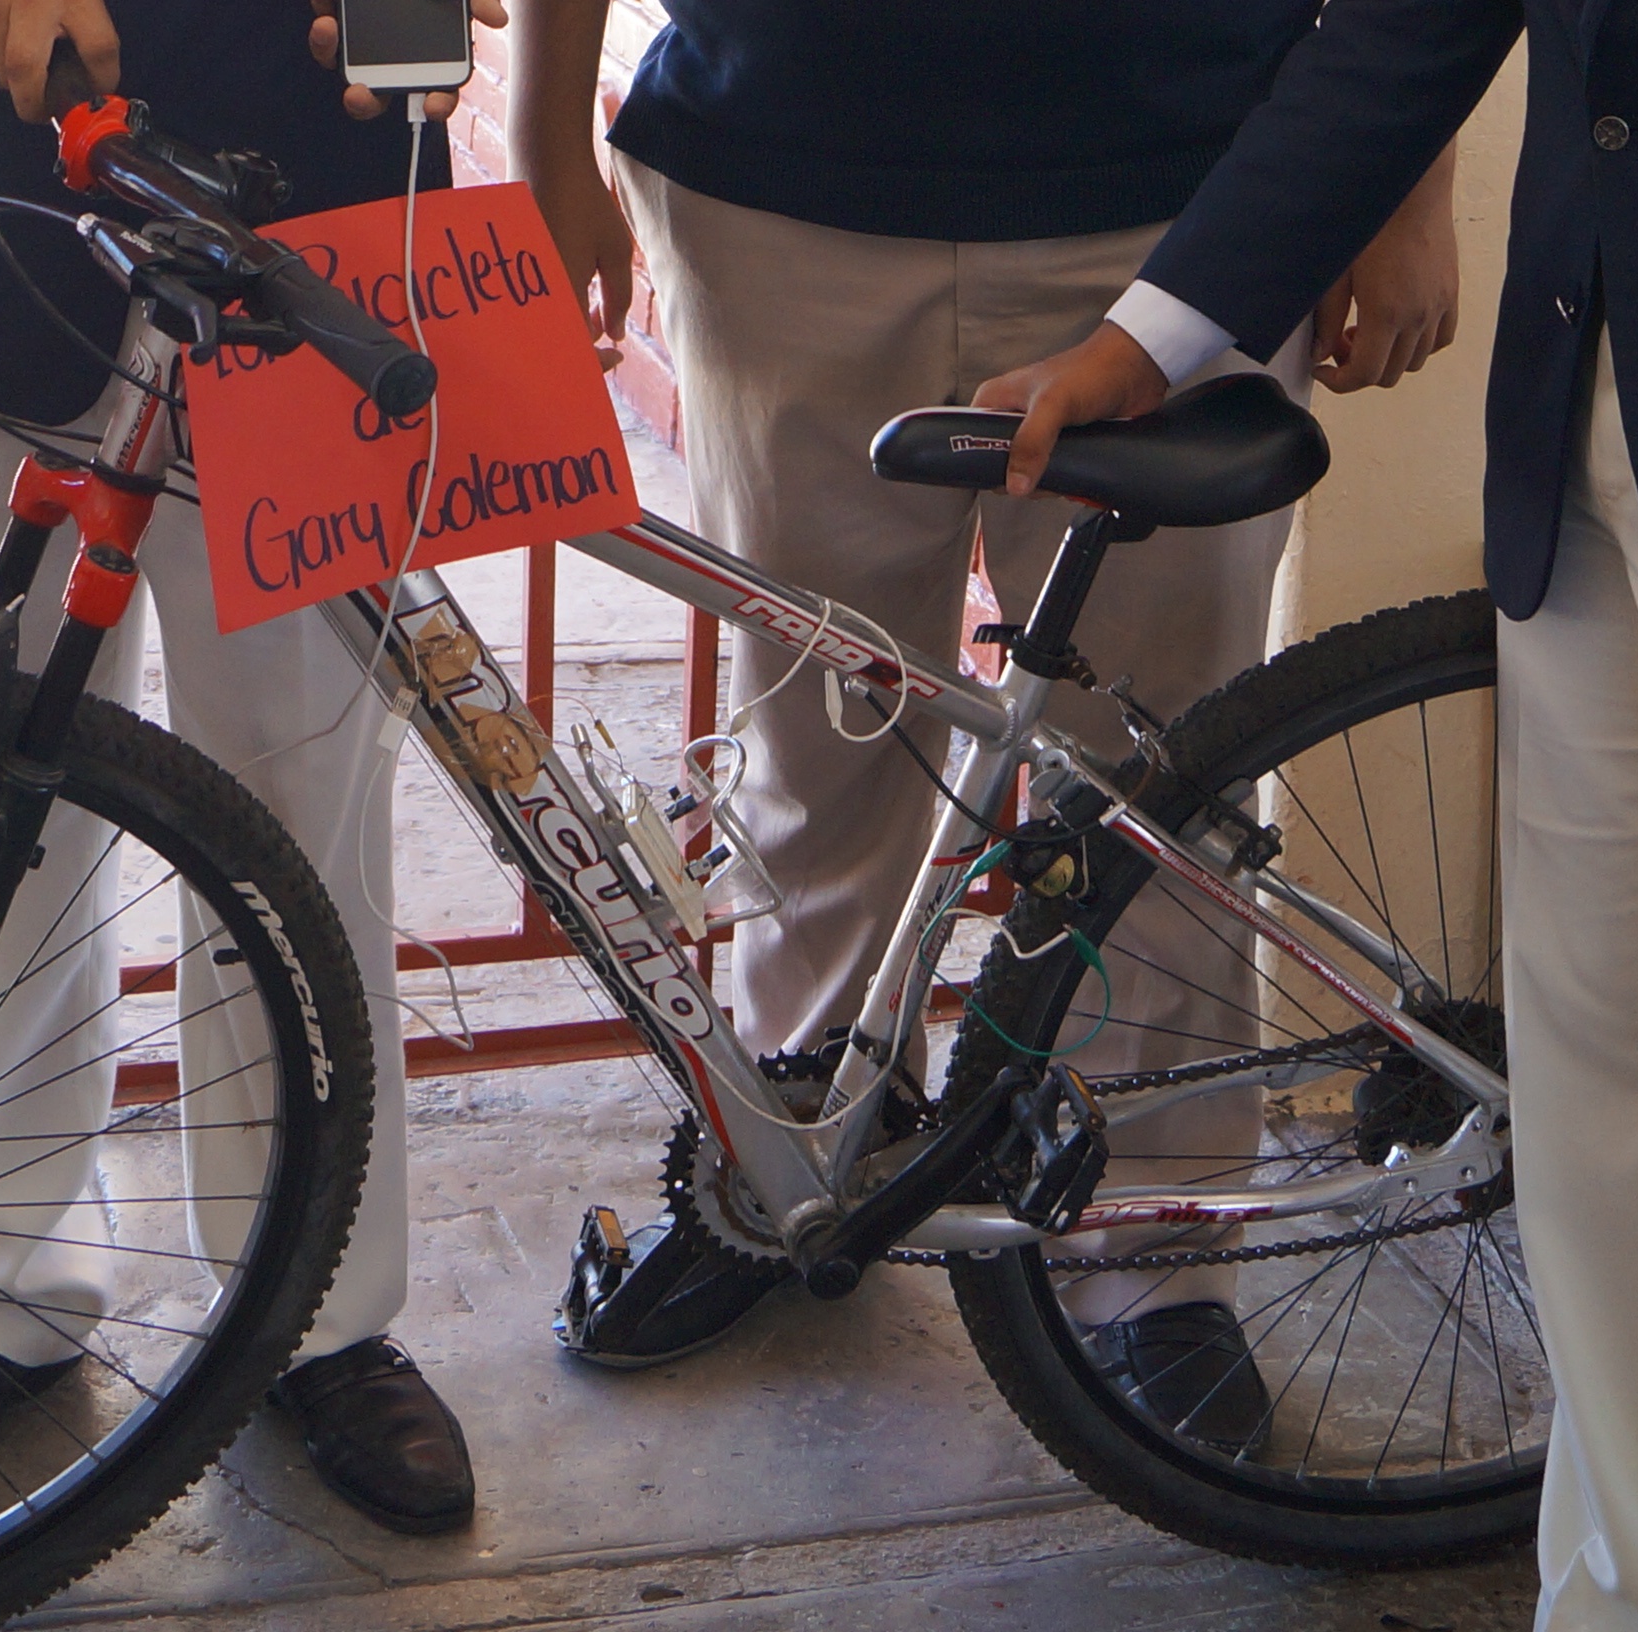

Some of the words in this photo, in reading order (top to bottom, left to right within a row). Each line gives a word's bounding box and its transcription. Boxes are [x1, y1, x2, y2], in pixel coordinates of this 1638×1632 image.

[243, 494, 392, 593] Gary
[405, 445, 620, 540] Coleman
[733, 594, 943, 700] rangr
